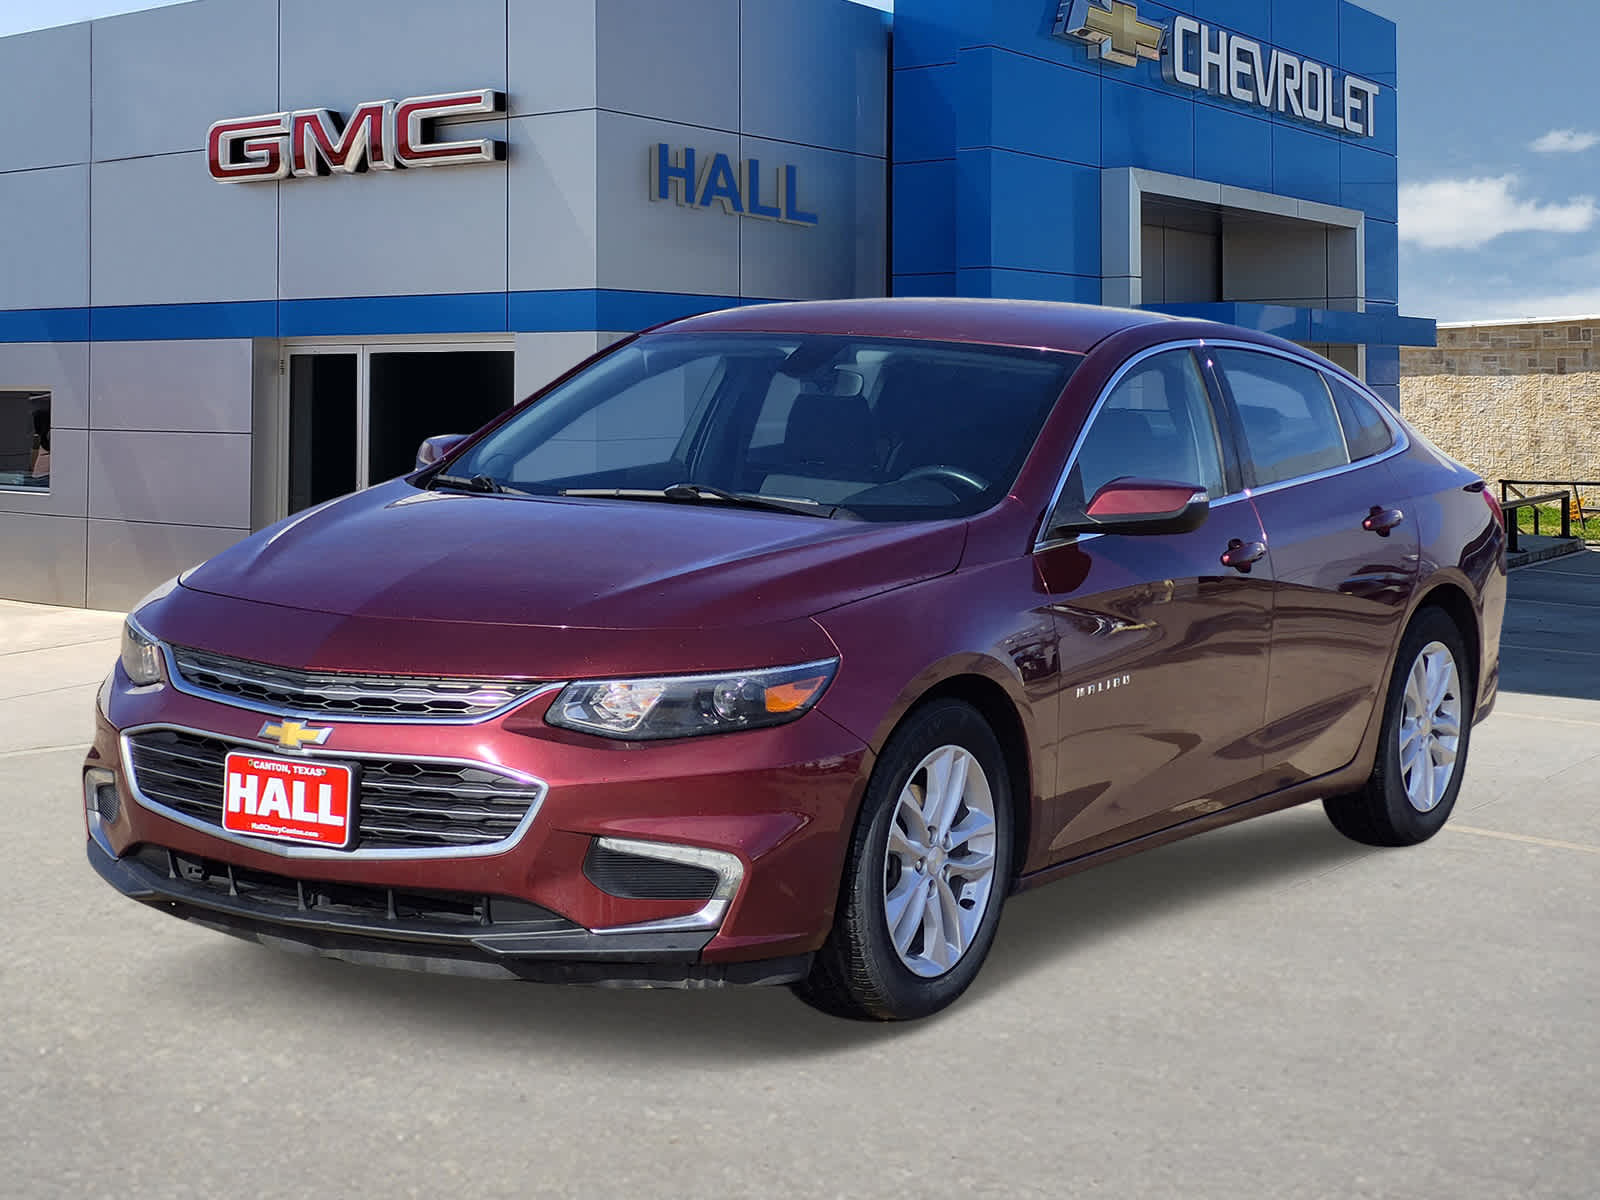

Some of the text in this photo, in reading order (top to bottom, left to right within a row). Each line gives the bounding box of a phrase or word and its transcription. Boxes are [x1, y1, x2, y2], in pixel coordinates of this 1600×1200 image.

[1172, 15, 1380, 137] CHEVROLET
[207, 88, 506, 184] GMC
[651, 142, 818, 227] HALL
[228, 772, 345, 827] HALL
[253, 760, 322, 777] CANTON, TEXAS
